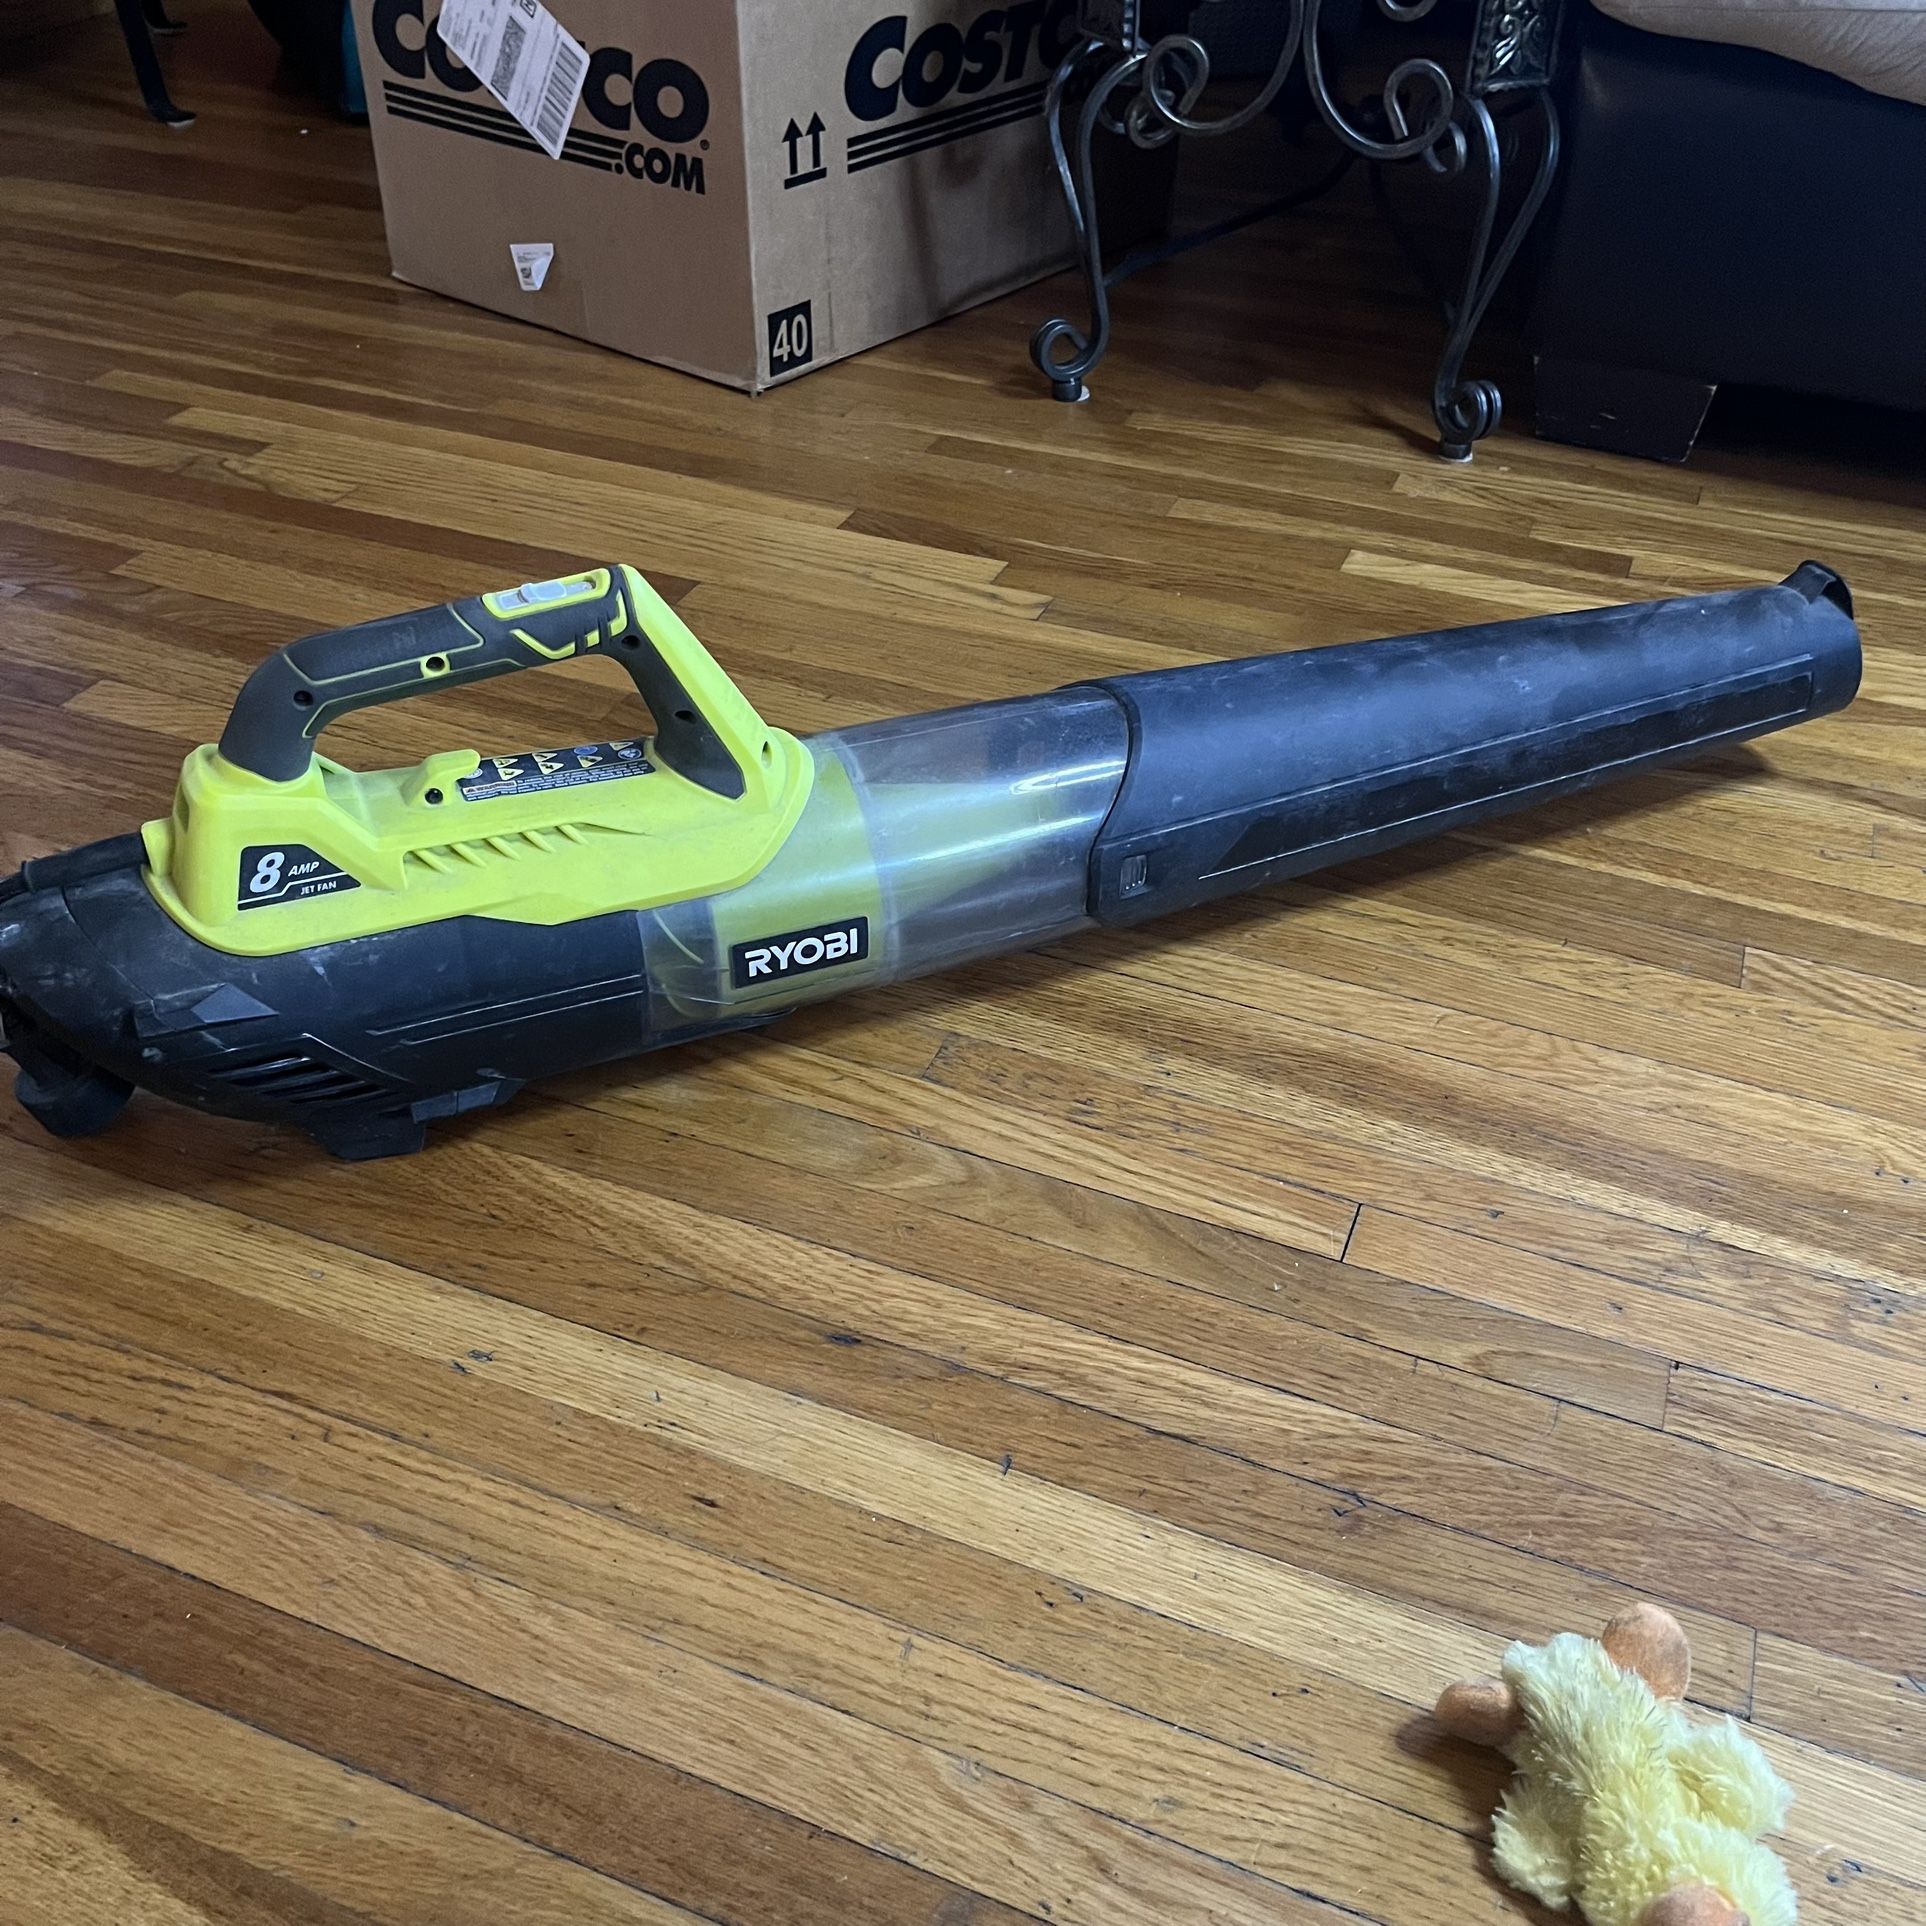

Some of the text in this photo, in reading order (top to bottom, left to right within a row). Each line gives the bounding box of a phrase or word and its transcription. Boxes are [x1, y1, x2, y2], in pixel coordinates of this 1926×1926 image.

[372, 0, 710, 143] COCO
[844, 0, 1078, 121] COSTC
[614, 142, 706, 195] .COM
[772, 314, 808, 363] 40
[249, 851, 320, 893] 8 AMP
[300, 880, 337, 895] JET FAN
[744, 927, 858, 978] RYOBI
